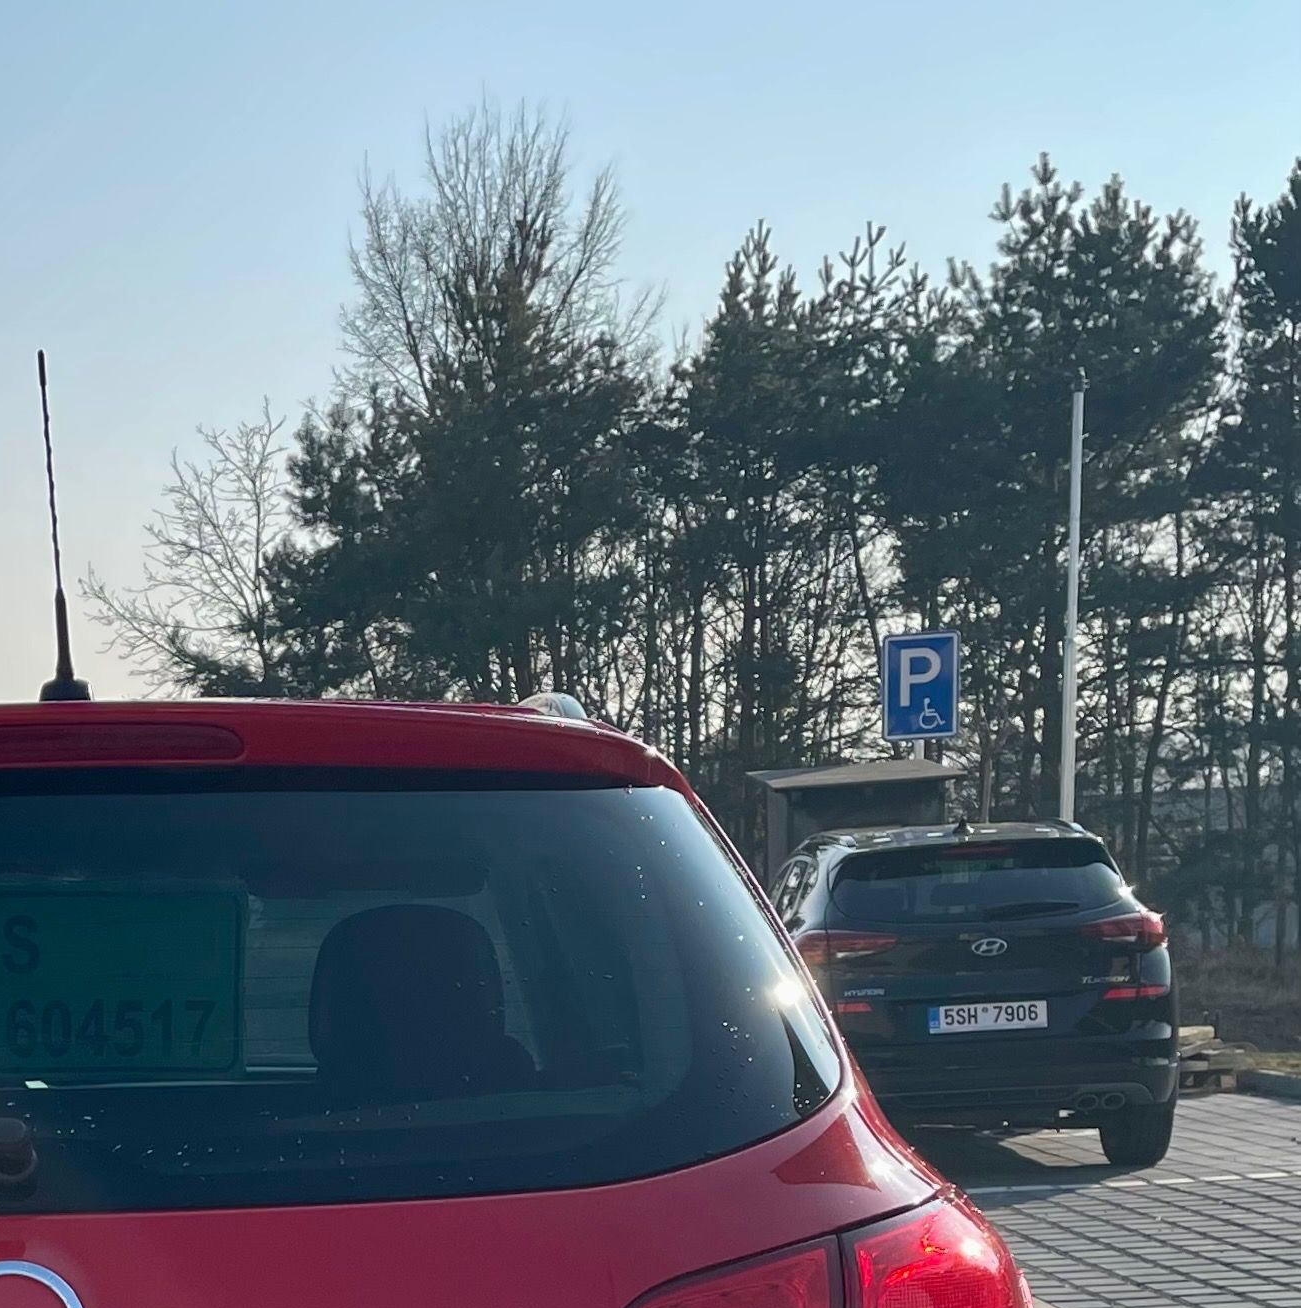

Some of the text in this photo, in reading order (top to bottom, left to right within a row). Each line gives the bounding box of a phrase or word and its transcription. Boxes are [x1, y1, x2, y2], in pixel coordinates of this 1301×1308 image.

[900, 648, 941, 707] P
[2, 914, 40, 974] S
[5, 1000, 217, 1058] 604517
[944, 1004, 1039, 1026] 5SH 7906
